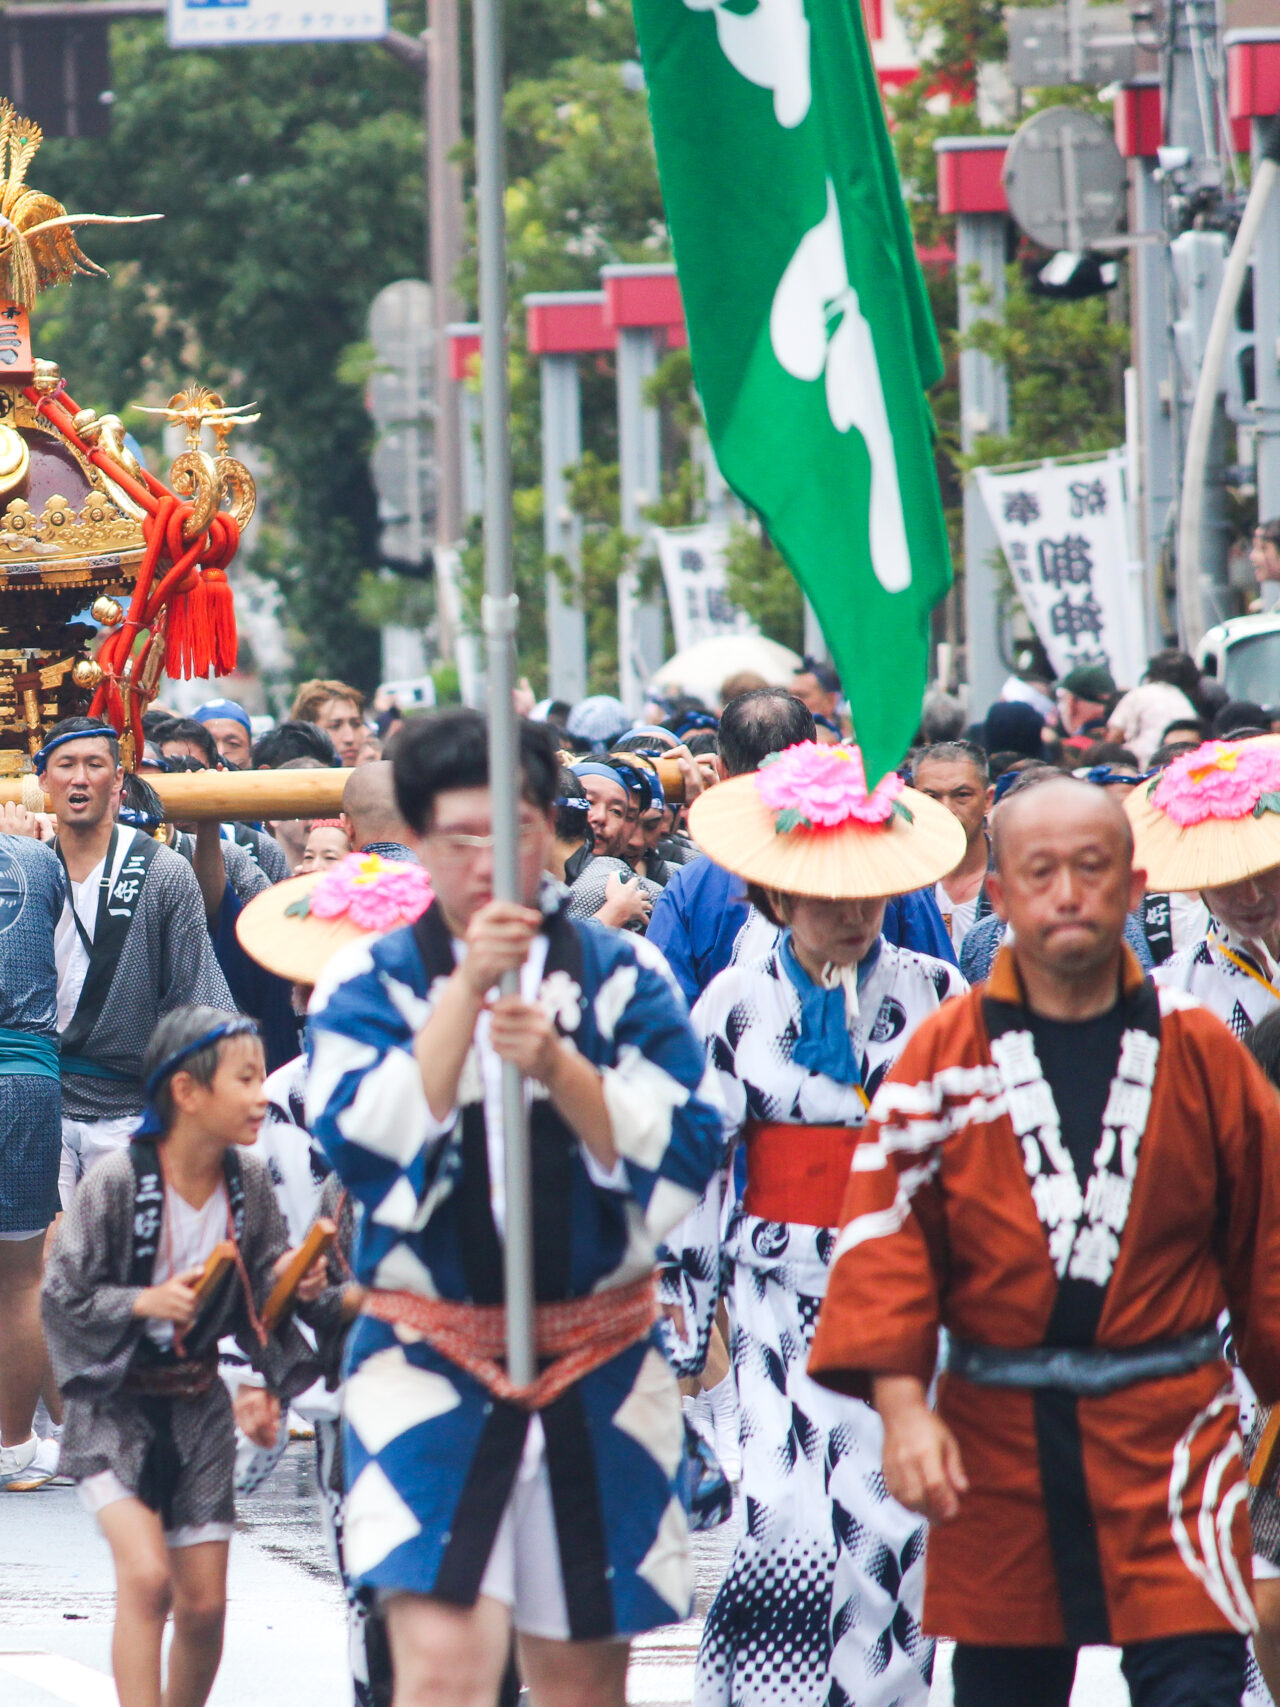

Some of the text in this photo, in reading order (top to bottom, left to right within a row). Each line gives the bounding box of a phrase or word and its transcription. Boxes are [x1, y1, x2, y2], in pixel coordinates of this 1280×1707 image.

[108, 855, 146, 918] 三好一
[134, 1173, 163, 1257] 三好一
